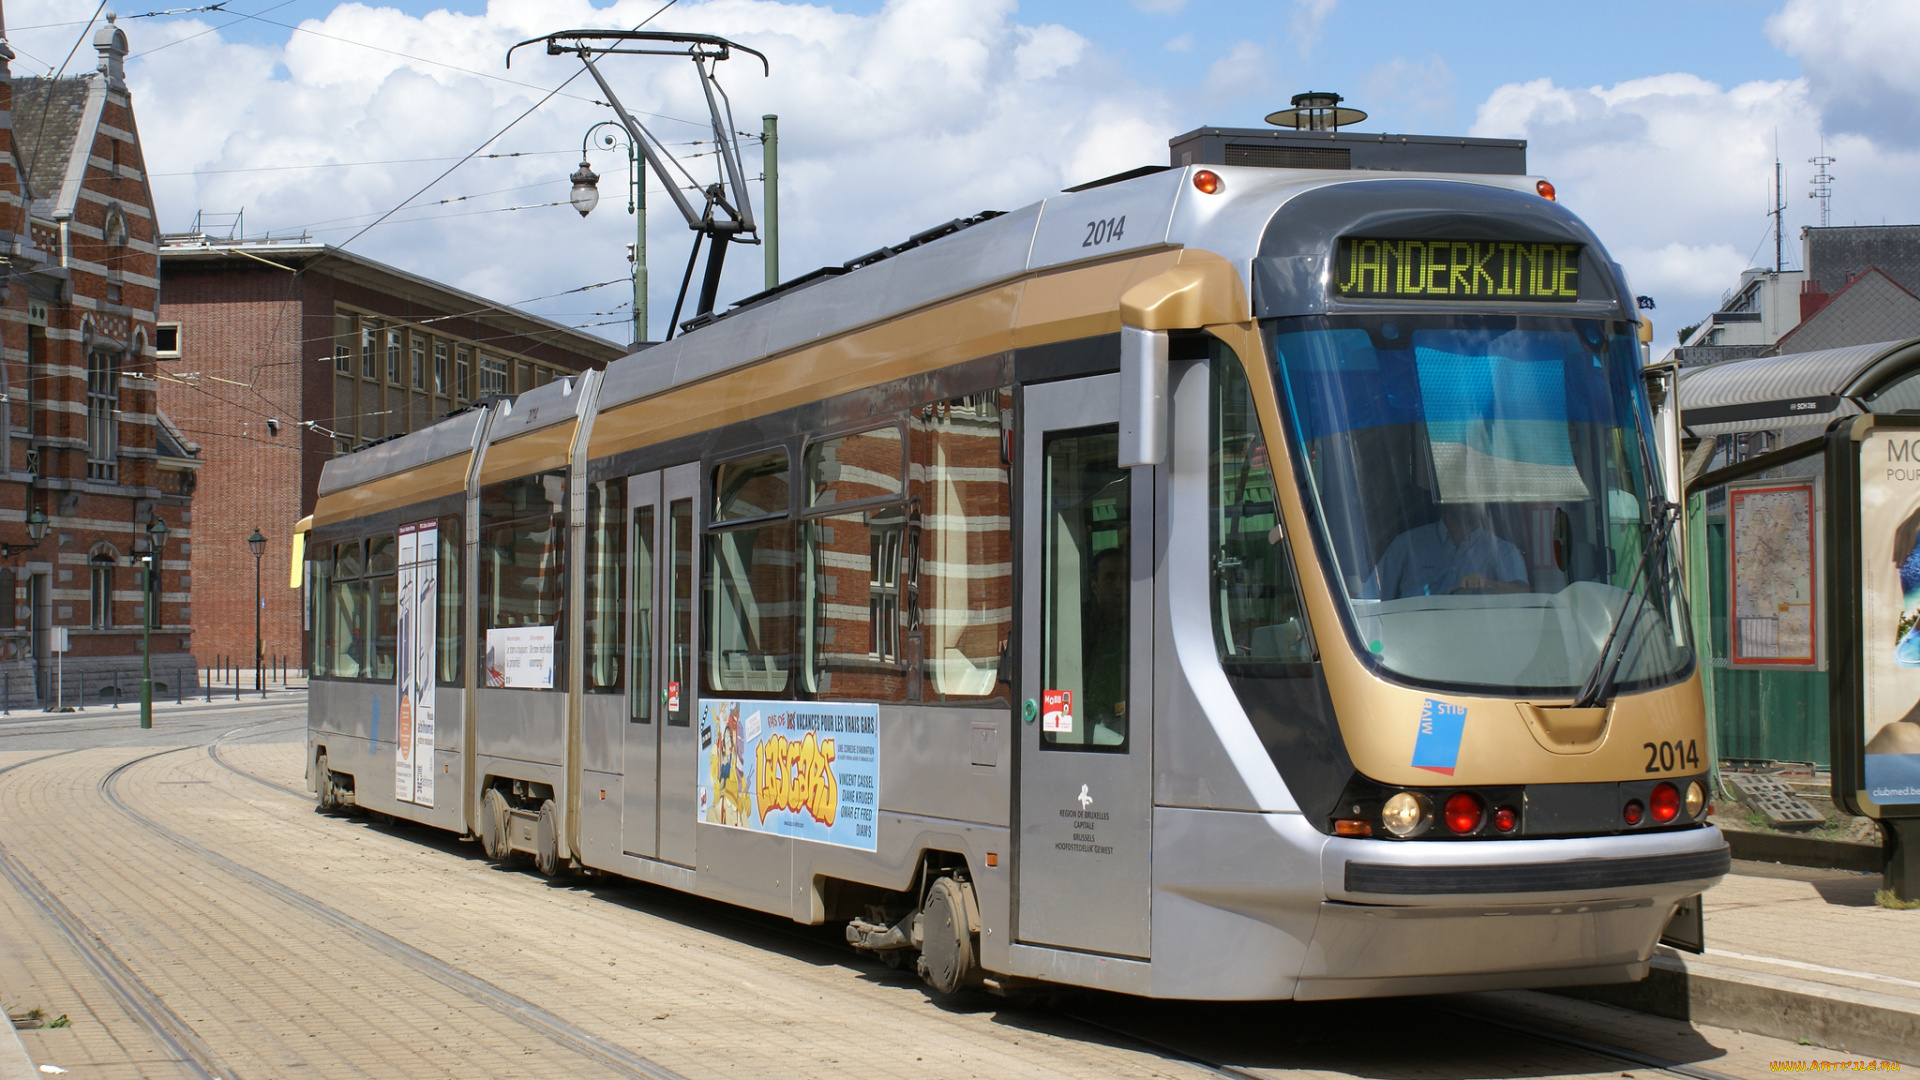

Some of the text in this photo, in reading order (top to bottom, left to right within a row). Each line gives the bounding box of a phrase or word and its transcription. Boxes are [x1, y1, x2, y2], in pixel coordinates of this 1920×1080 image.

[1082, 215, 1126, 248] 2014
[1437, 703, 1465, 715] STIB
[796, 713, 820, 732] VACANCES
[820, 714, 834, 732] POUR
[834, 714, 844, 733] LES
[844, 715, 860, 734] VRAIS
[860, 716, 875, 735] GARS
[1421, 700, 1433, 735] MIVB
[1643, 739, 1700, 773] 2014
[755, 730, 838, 828] LASCARS
[838, 772, 874, 789] VINCENT CASSEL
[855, 791, 874, 806] KRUGER
[1872, 787, 1920, 797] clubmed.be
[840, 805, 873, 821] OMAR ET FRED
[1059, 809, 1110, 821] REGION DE BRUXELLES
[1073, 820, 1095, 830] CAPITALE
[1072, 833, 1096, 843] BRUSSELS
[1093, 845, 1114, 855] GEWEST
